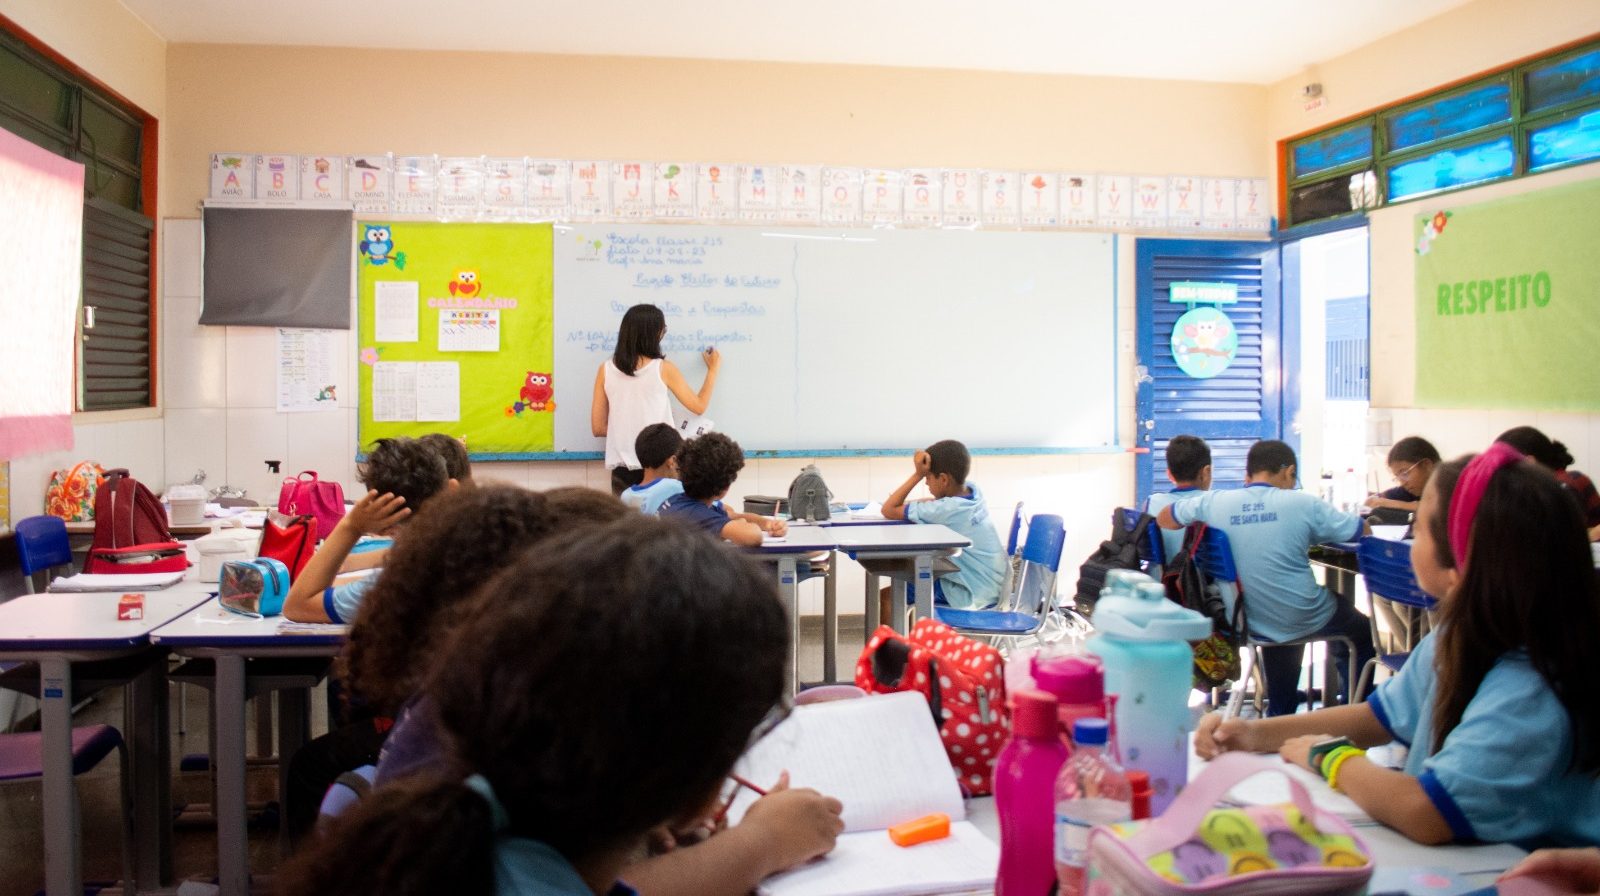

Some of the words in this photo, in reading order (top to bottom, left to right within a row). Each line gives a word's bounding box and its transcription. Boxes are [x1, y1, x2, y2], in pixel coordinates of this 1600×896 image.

[223, 170, 241, 188] A
[272, 172, 285, 190] B
[315, 174, 330, 191] C
[361, 171, 377, 191] D
[408, 175, 420, 192] E
[221, 187, 243, 196] AVIÃO
[267, 190, 287, 198] BOLO
[313, 191, 332, 199] CASA
[498, 180, 512, 195] G
[542, 179, 553, 196] H
[585, 181, 594, 195] I
[628, 181, 640, 197] J
[668, 180, 680, 197] K
[711, 184, 720, 199] L
[752, 185, 766, 199] M
[794, 185, 805, 198] N
[834, 186, 848, 201] O
[875, 186, 887, 202] P
[916, 187, 929, 205] Q
[995, 189, 1005, 207] S
[1070, 189, 1083, 206] U
[1108, 194, 1121, 209] V
[1141, 193, 1159, 209] W
[1178, 192, 1189, 209] X
[1248, 197, 1257, 212] Z
[1436, 270, 1552, 316] RESPEITO
[427, 294, 518, 309] CALENDÁRIO
[1242, 503, 1251, 512] EC
[1230, 515, 1241, 526] CRE
[1242, 513, 1259, 524] SANTA
[1260, 512, 1278, 523] MARIA
